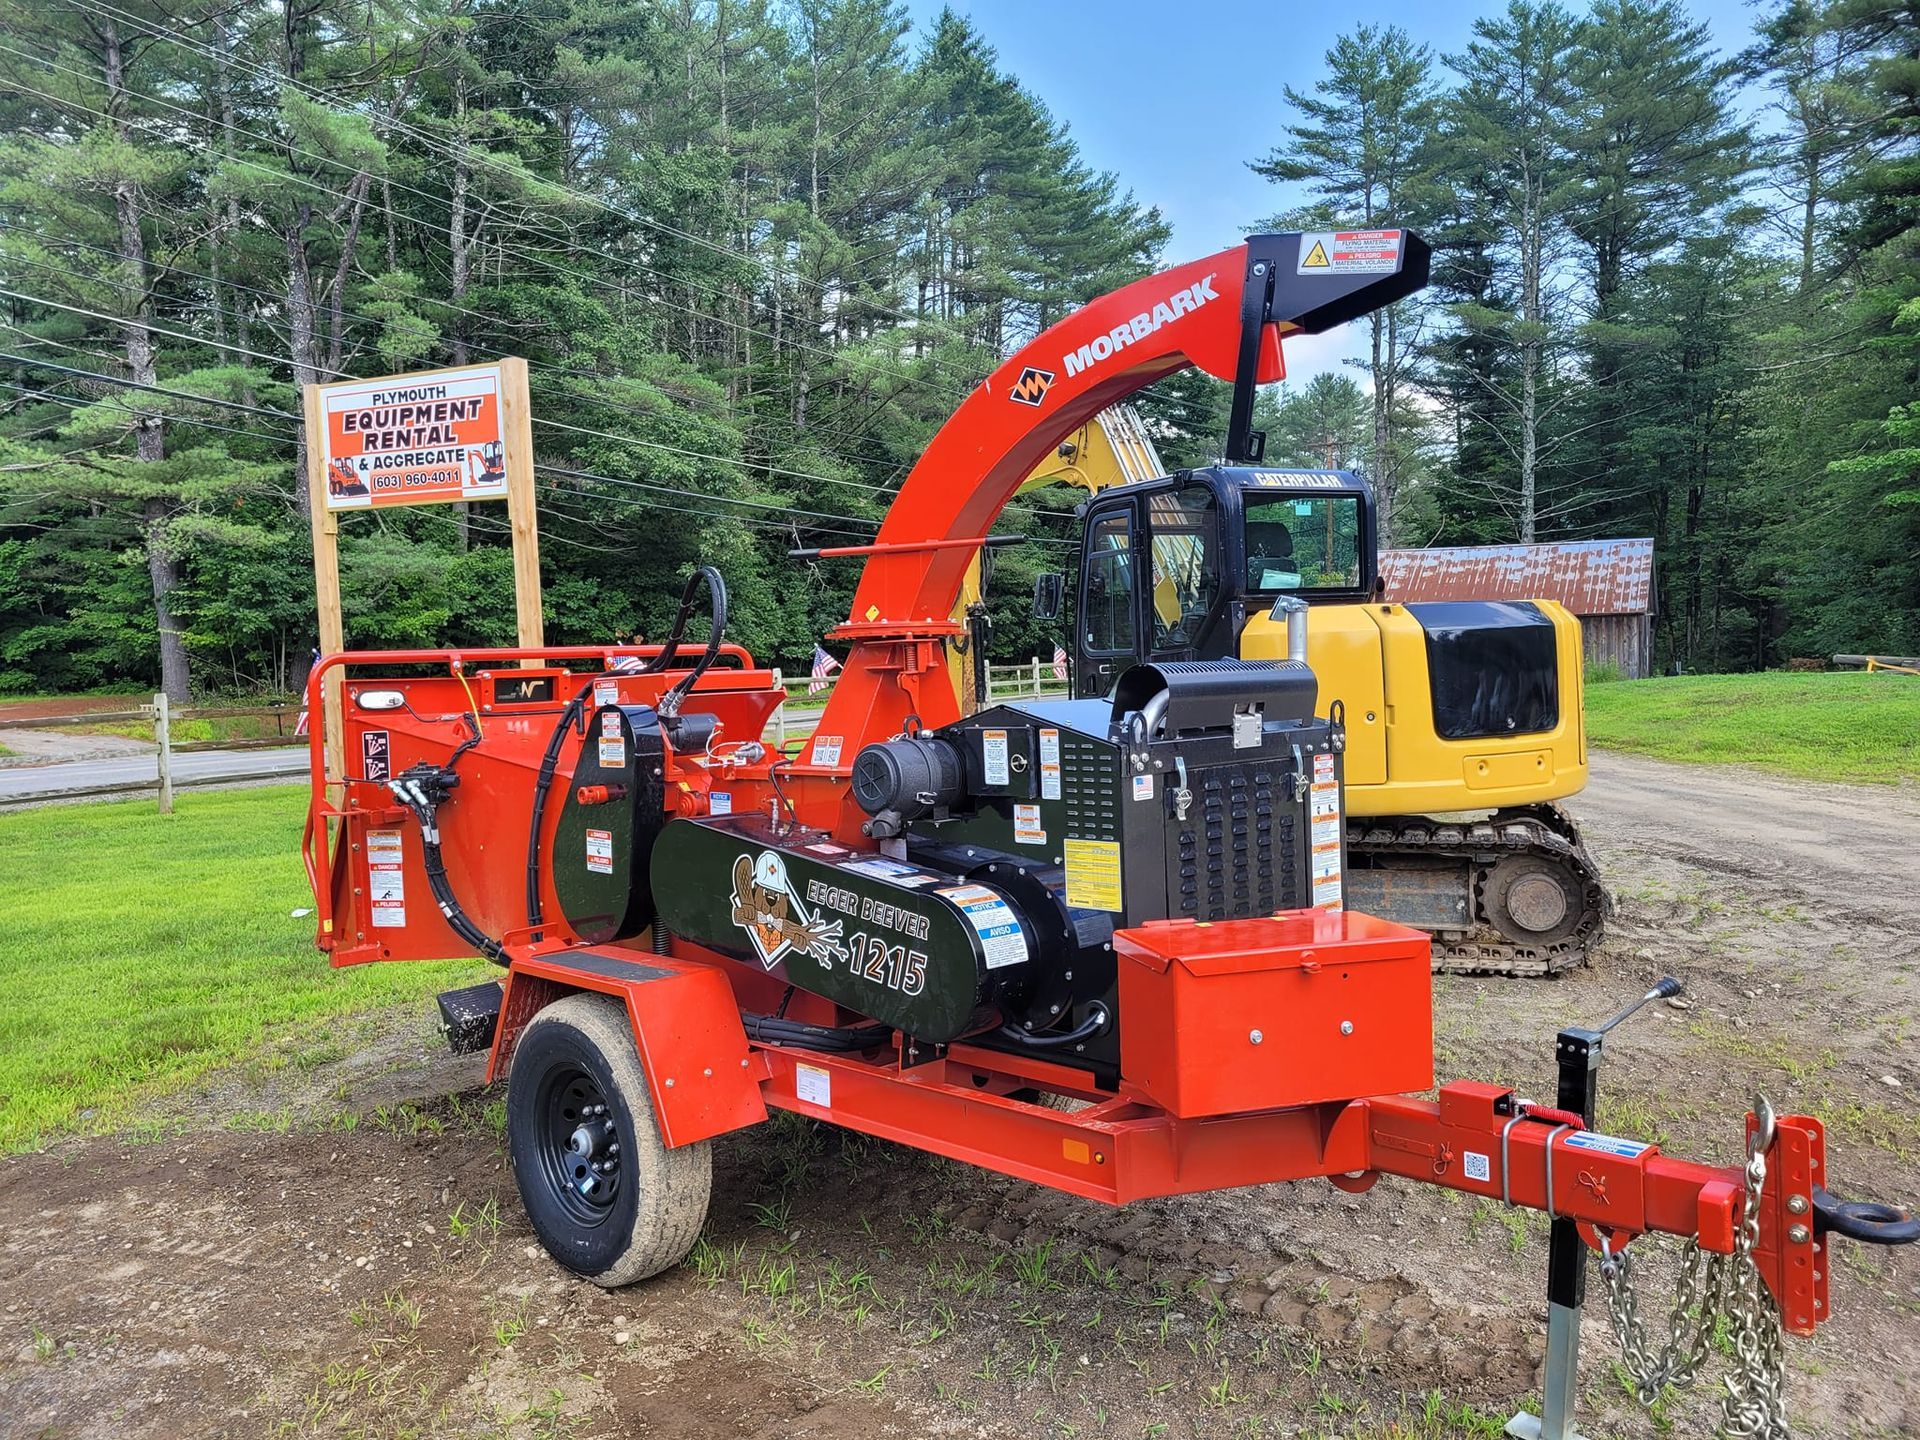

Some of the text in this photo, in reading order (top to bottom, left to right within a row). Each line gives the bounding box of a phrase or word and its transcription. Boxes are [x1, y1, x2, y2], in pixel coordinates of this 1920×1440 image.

[373, 386, 446, 405] PLYMOUTH
[344, 399, 482, 432] EQUIPMENT
[363, 425, 457, 451] RENTAL
[359, 448, 465, 471] & AGGREGATE
[373, 471, 460, 489] (603) 960-4011
[1254, 472, 1342, 487] CATERPILLAR
[806, 879, 930, 940] EEGER BEEVER
[970, 902, 996, 912] NOTICE
[990, 925, 1011, 937] AVISO
[849, 932, 928, 996] 1215
